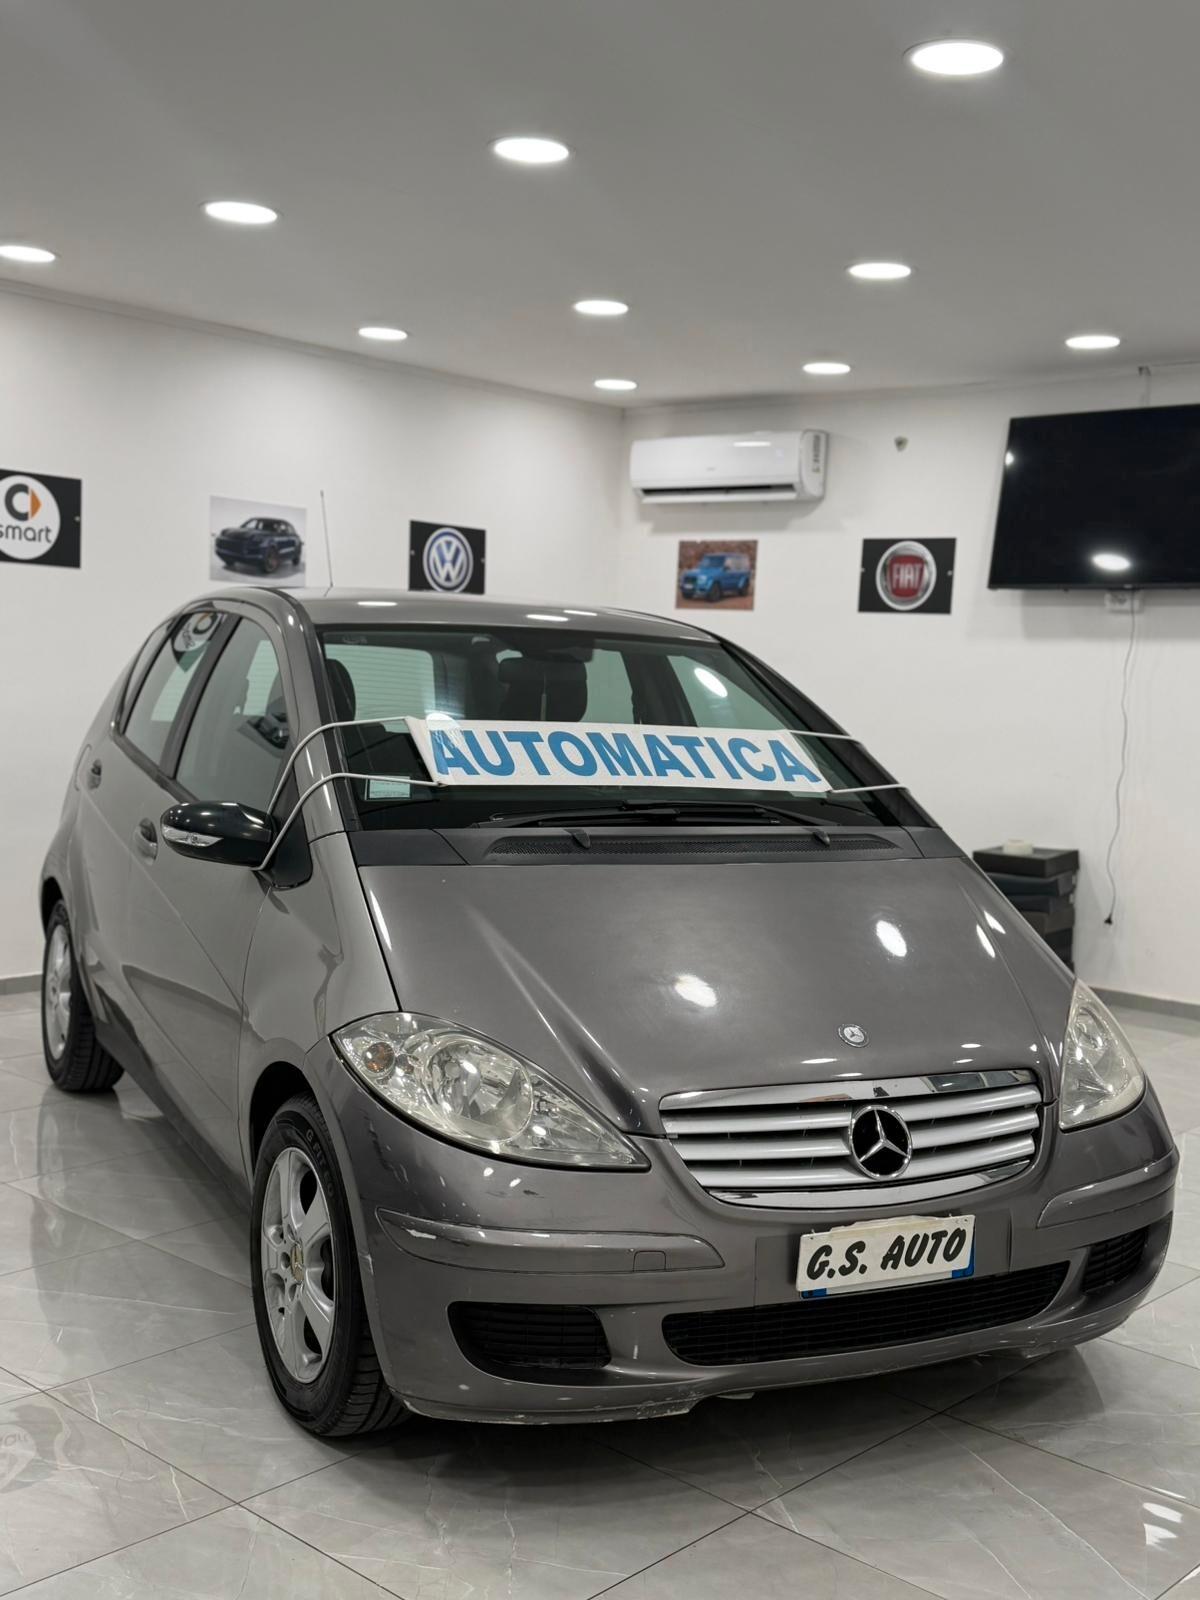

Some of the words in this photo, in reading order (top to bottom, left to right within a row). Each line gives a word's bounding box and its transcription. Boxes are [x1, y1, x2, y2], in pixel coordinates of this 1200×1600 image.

[892, 562, 922, 590] FIAT
[430, 730, 821, 783] AUTOMATICA
[806, 1240, 868, 1281] G.S.
[880, 1227, 967, 1271] AUTO
